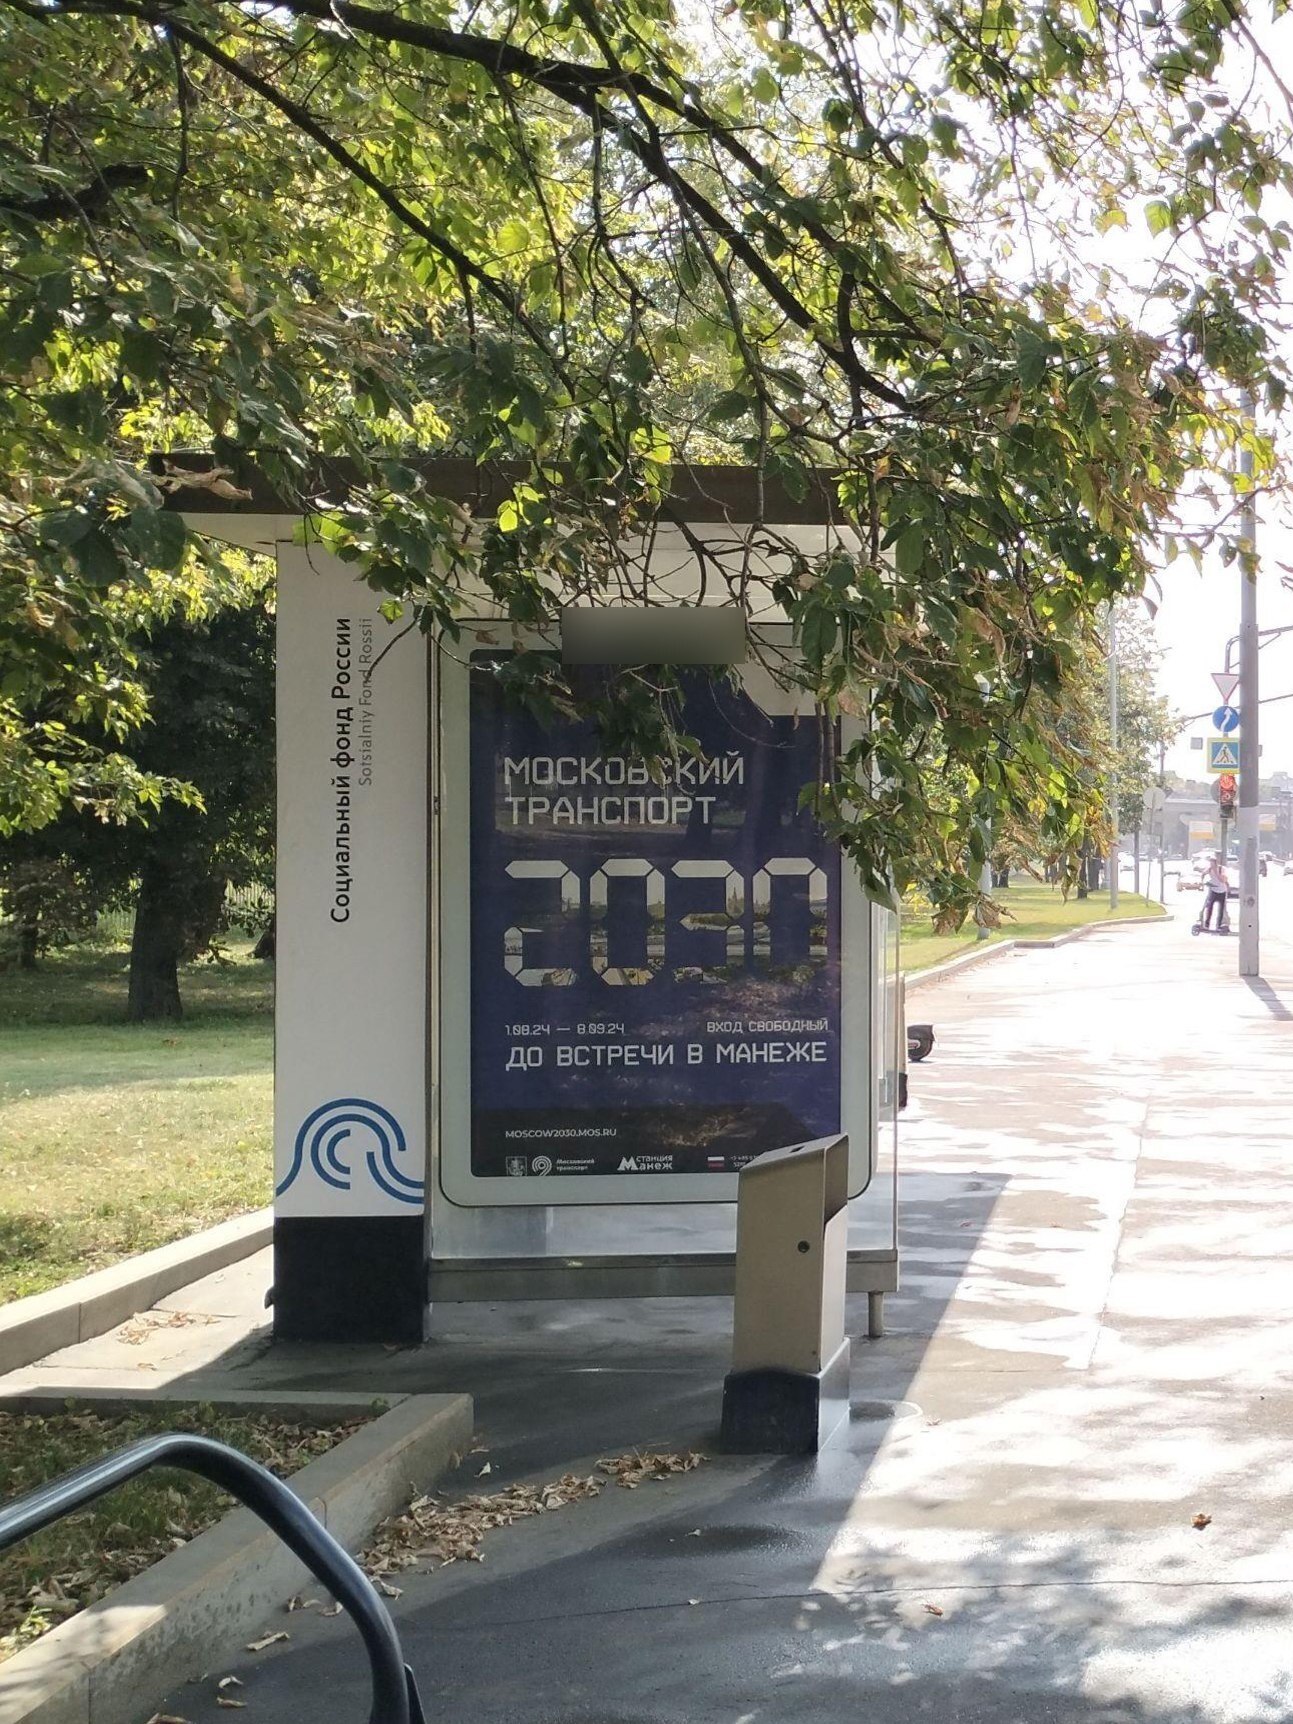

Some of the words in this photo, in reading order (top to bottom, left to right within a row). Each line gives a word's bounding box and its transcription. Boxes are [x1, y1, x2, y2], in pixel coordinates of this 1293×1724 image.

[331, 618, 351, 699] России
[358, 618, 373, 664] Rossii
[358, 669, 373, 706] Fond
[330, 706, 355, 768] фонд
[358, 710, 375, 786] Sotsialniy
[504, 750, 745, 785] МОСКОВСКИЙ
[504, 796, 717, 825] ТРАНСПОРТ
[330, 776, 353, 923] Социальный
[503, 857, 828, 987] 2030
[706, 1021, 744, 1034] ВХОД
[748, 1018, 829, 1033] СВОБОДНЫЙ
[505, 1046, 543, 1071] ДО
[556, 1044, 674, 1067] ВСТРЕЧИ
[687, 1043, 703, 1065] В
[716, 1041, 828, 1064] МАНЕЖЕ
[505, 1128, 617, 1139] MOSCOW2030.MOS.RU
